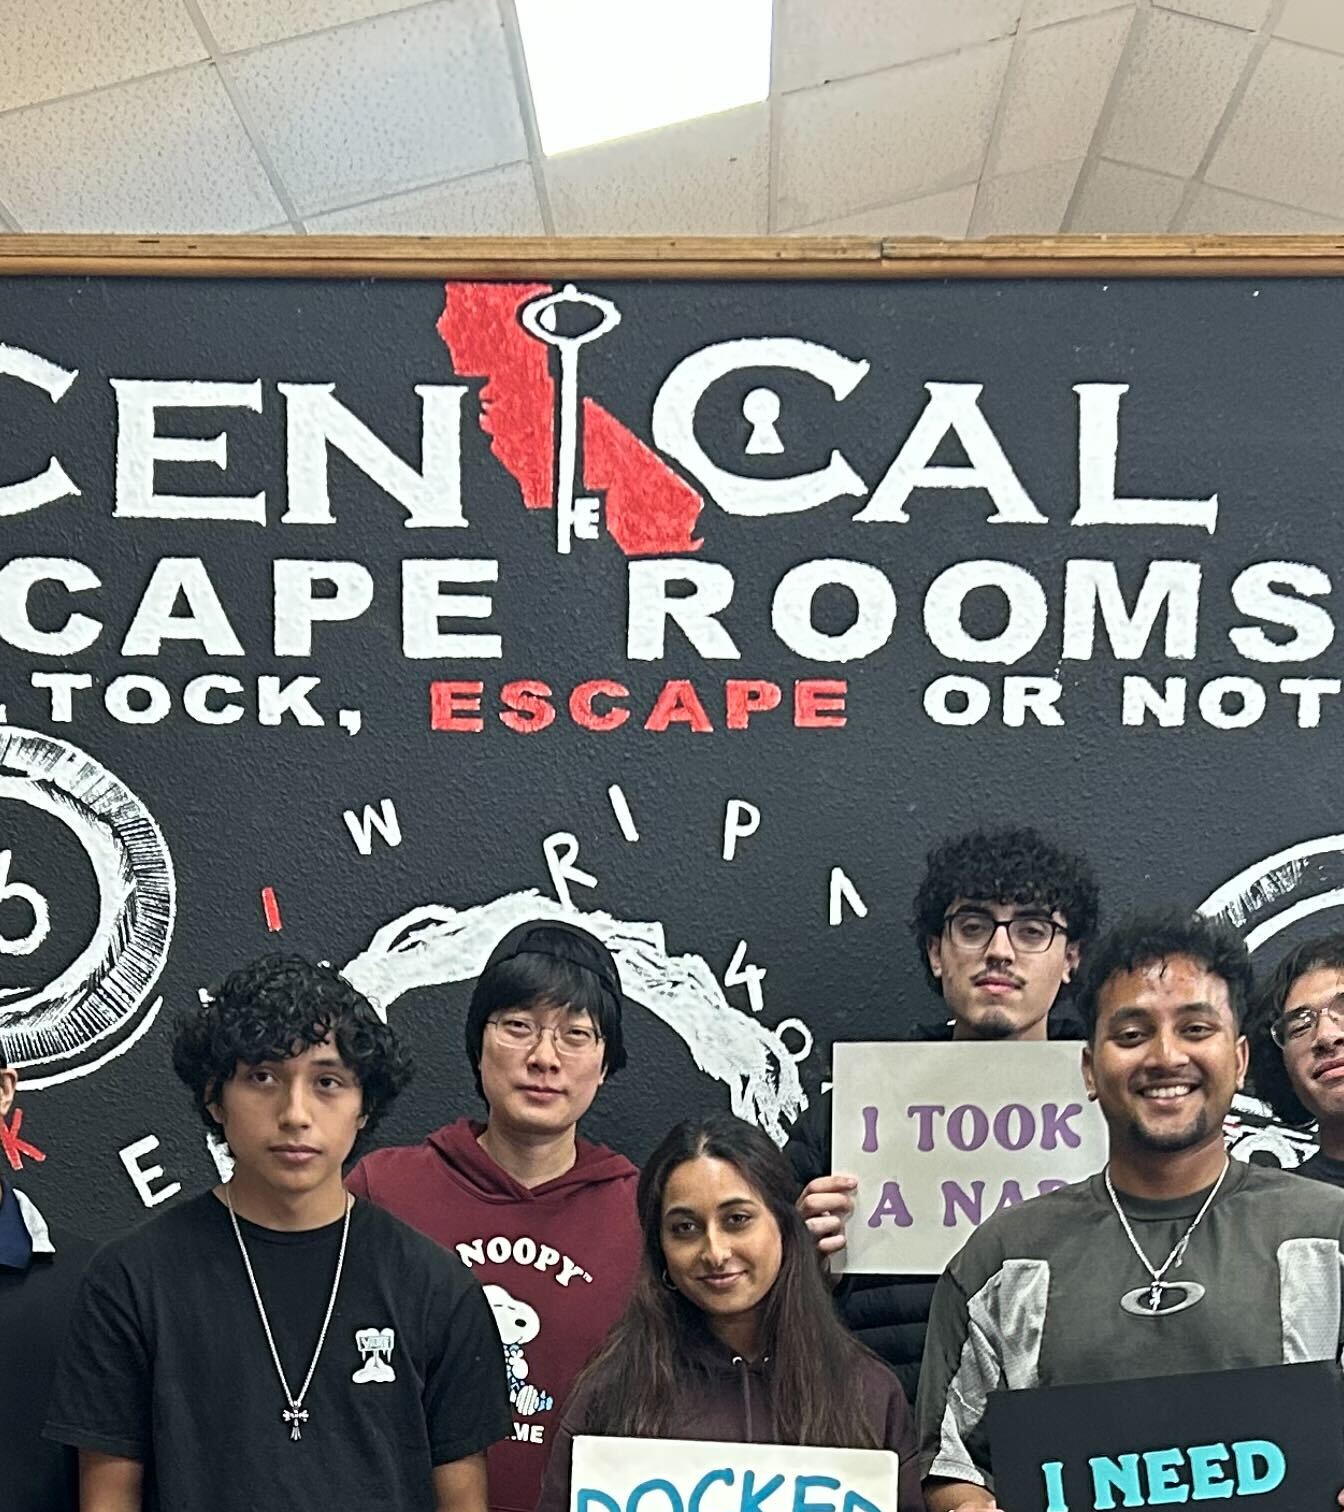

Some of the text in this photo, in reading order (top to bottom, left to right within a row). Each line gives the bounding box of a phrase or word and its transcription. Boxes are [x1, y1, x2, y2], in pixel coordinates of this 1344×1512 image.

[627, 558, 1336, 664] ROOMS
[31, 673, 362, 736] TOCK,
[429, 678, 849, 732] ESCAPE
[924, 675, 1065, 728] OR
[1121, 675, 1342, 729] NOT
[862, 1103, 1083, 1152] I TOOK
[868, 1182, 913, 1228] A
[1089, 1440, 1286, 1510] NEED
